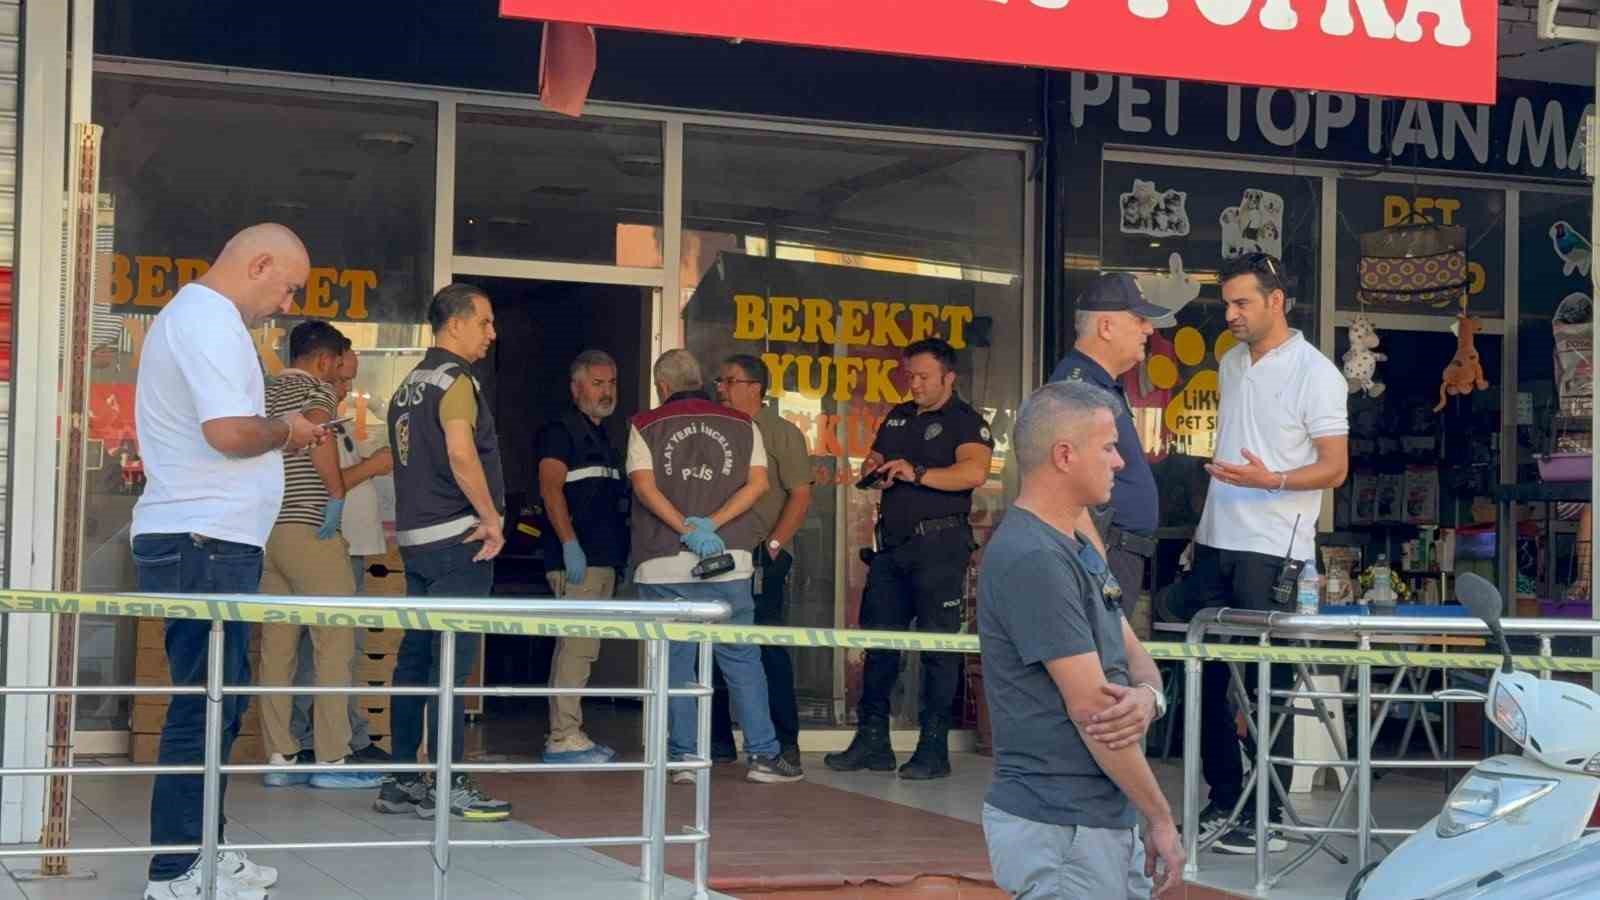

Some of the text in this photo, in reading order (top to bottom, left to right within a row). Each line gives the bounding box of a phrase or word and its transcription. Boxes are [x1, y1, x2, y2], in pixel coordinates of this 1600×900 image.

[733, 294, 973, 350] BEREKET
[761, 352, 912, 405] YUFK
[1175, 415, 1202, 430] PET
[663, 443, 674, 476] OLAY
